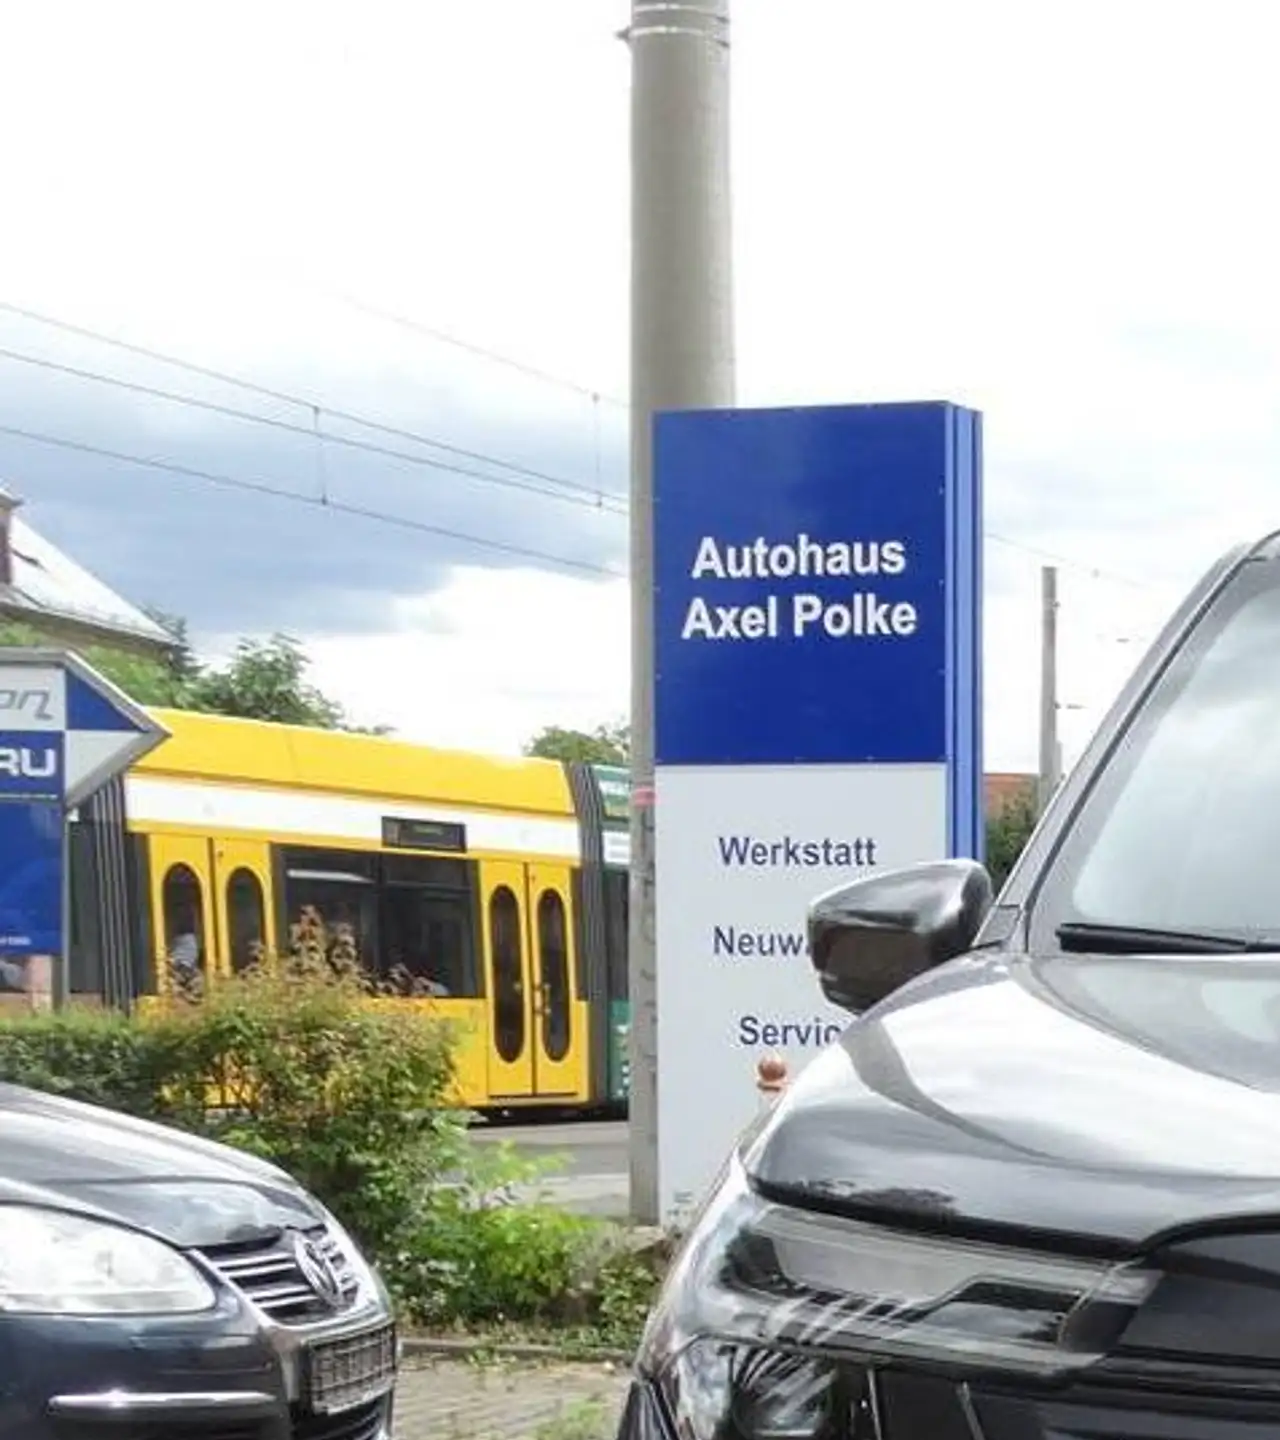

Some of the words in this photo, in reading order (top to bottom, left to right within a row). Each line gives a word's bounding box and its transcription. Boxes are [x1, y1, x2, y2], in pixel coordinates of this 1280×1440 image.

[691, 533, 907, 579] Autohaus
[680, 596, 778, 641] Axel
[793, 592, 918, 638] Polke
[718, 836, 877, 867] Werkstatt
[712, 925, 811, 957] Neuw
